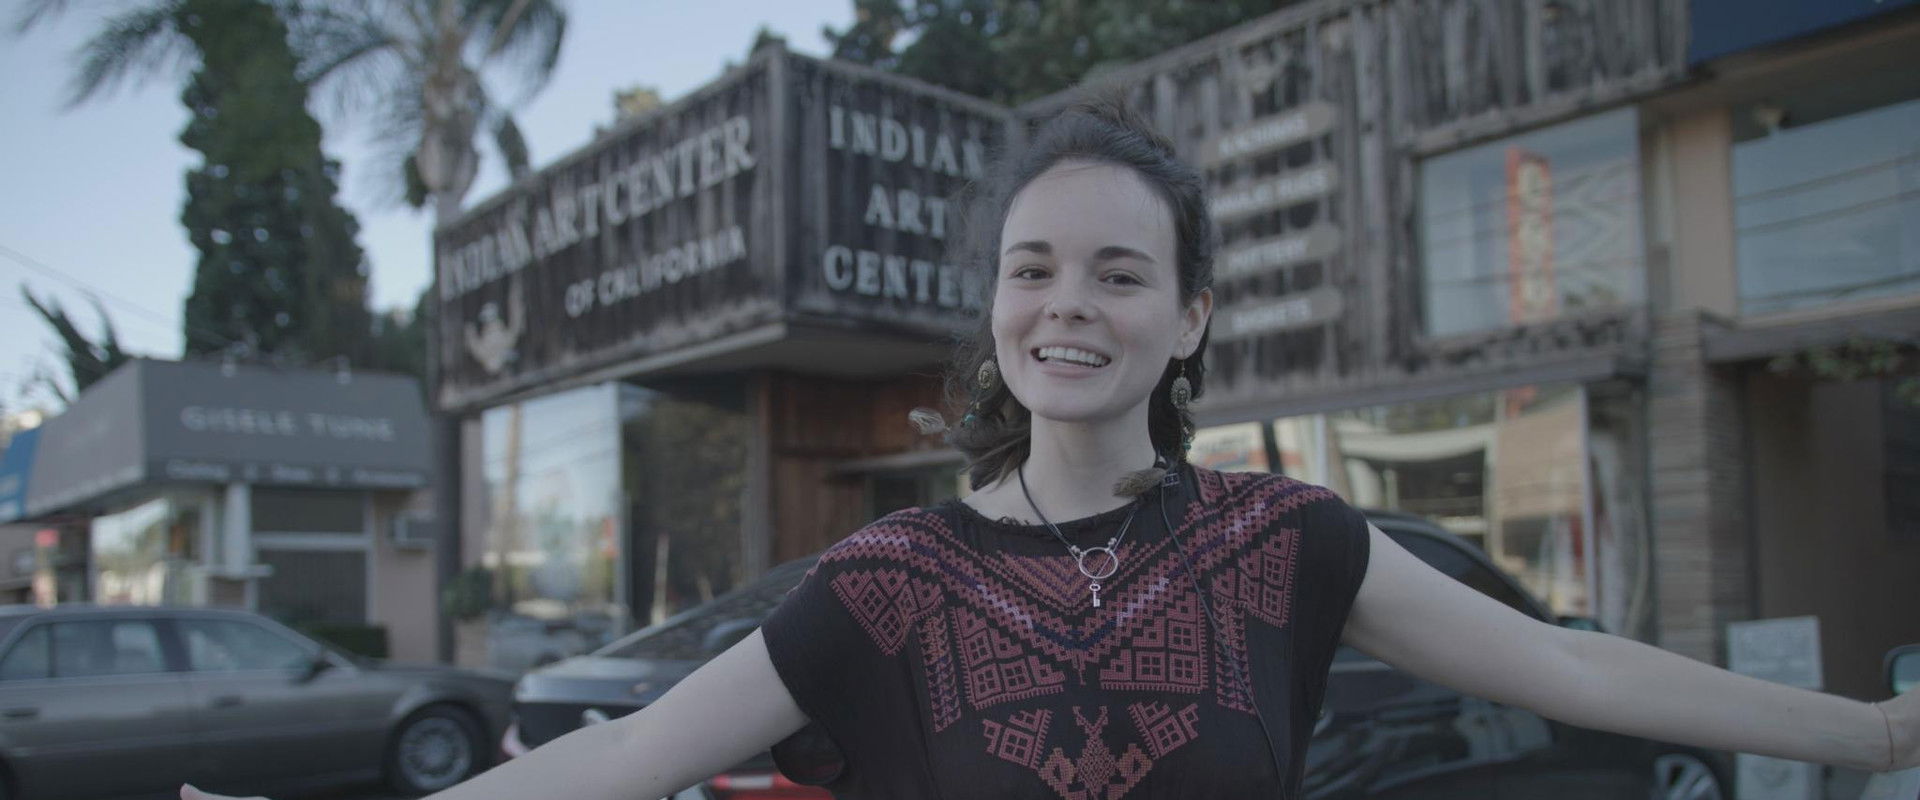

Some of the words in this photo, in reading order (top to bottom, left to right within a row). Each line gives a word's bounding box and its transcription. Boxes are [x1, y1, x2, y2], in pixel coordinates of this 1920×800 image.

[439, 220, 532, 302] INDIAN
[533, 183, 601, 260] ART
[602, 114, 756, 226] CENTER
[864, 182, 952, 239] ART
[564, 279, 595, 319] OF
[597, 224, 747, 306] CALIFORNIA
